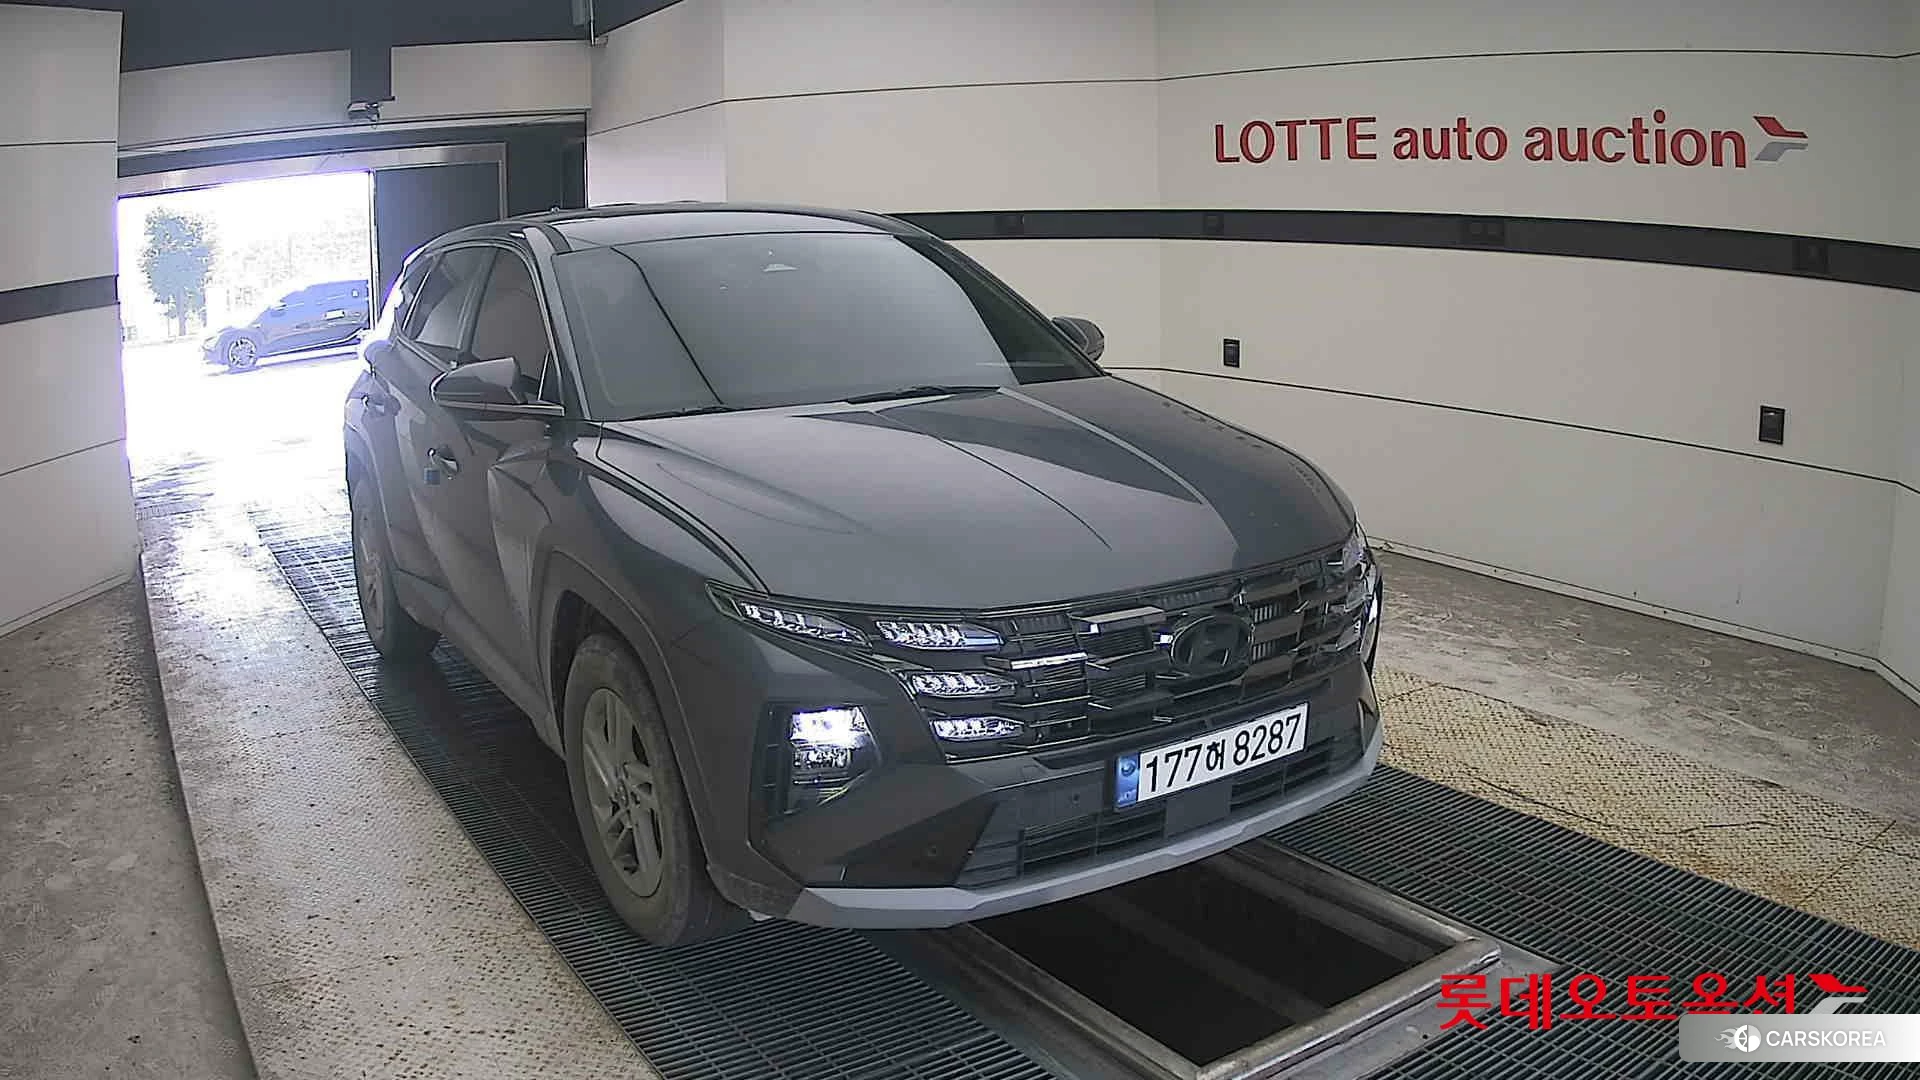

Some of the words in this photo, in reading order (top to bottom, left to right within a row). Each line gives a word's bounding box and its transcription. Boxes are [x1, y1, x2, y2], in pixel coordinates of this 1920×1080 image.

[1215, 117, 1377, 162] LOTTE
[1393, 117, 1508, 161] auto
[1524, 109, 1747, 168] auction
[1146, 740, 1226, 792] 177허
[1233, 713, 1302, 766] 8287
